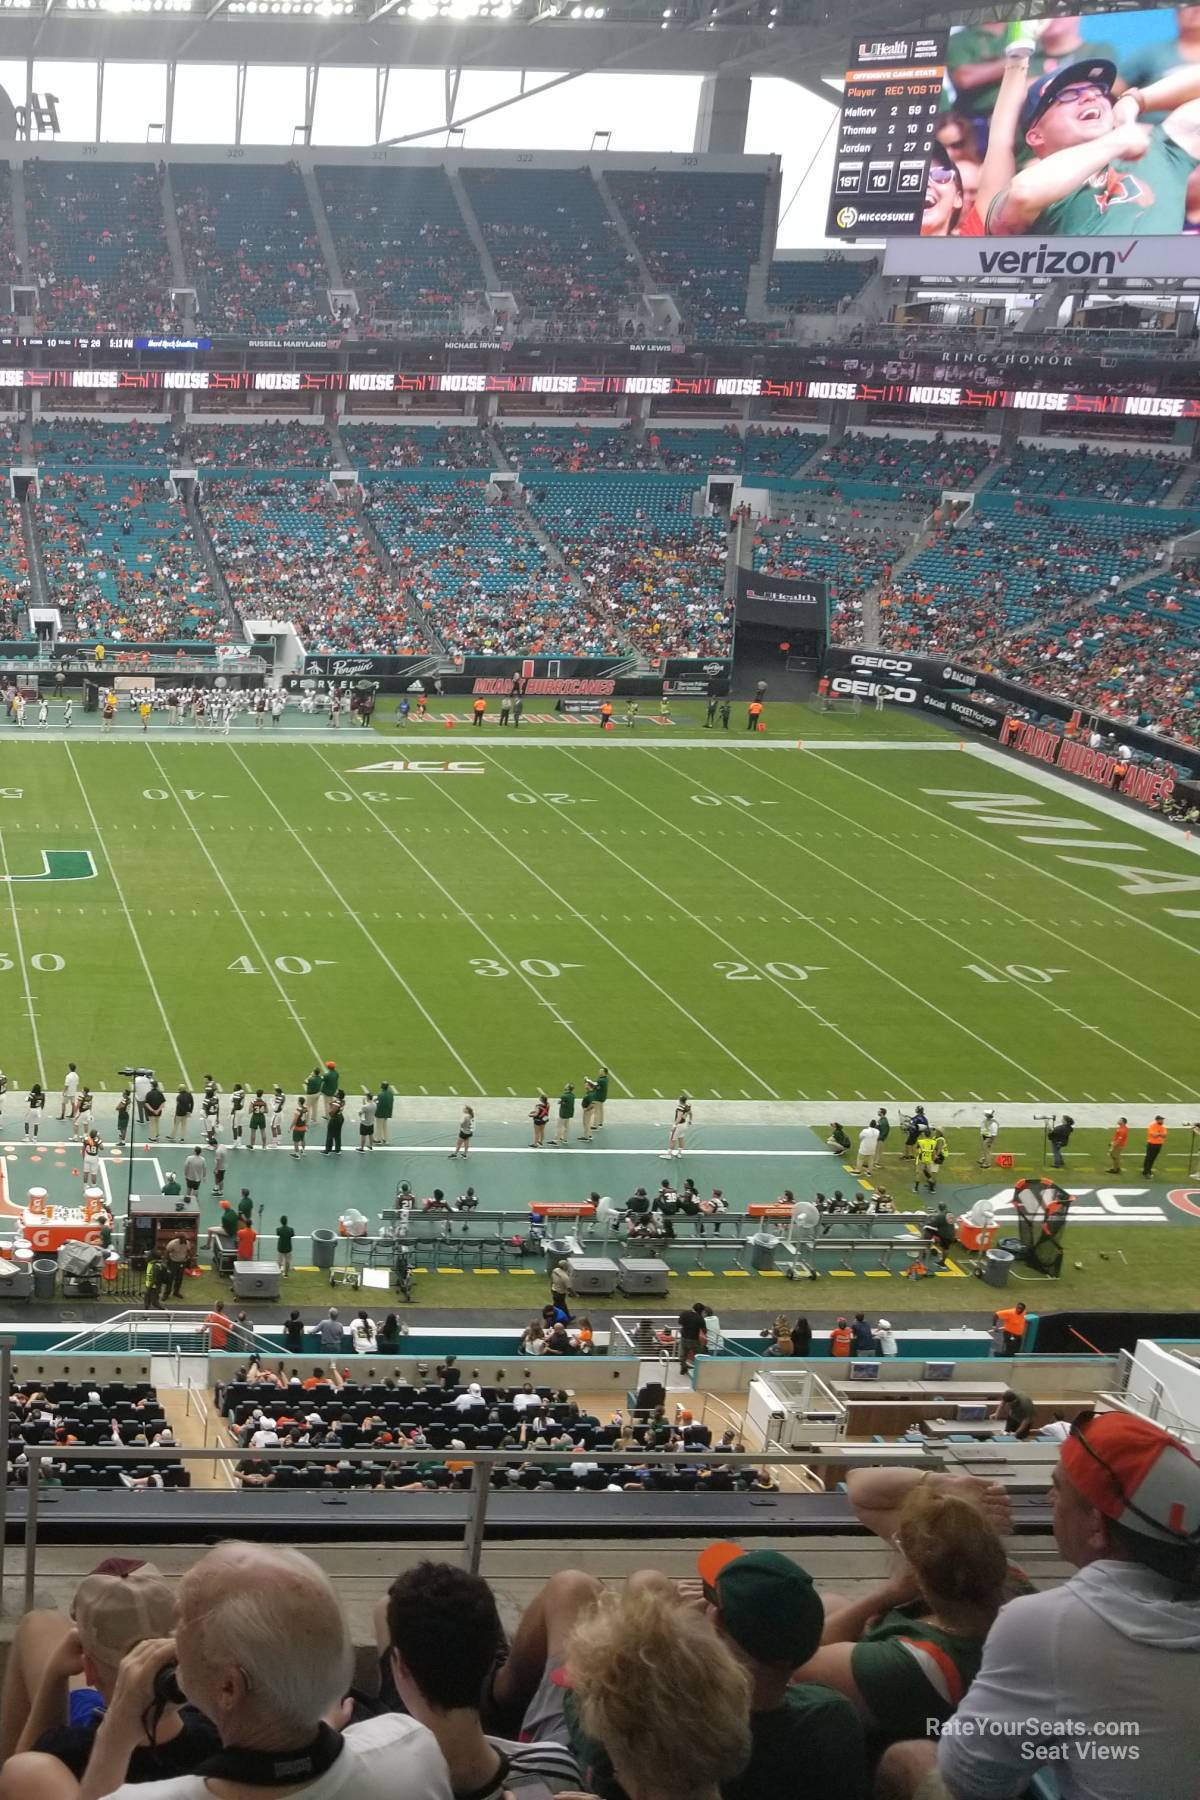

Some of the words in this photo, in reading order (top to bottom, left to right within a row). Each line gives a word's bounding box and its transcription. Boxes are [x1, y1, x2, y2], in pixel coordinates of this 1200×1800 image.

[848, 88, 876, 98] Player
[885, 86, 904, 95] REC
[907, 85, 927, 95] YDS
[929, 84, 941, 93] TD
[845, 107, 877, 117] Mallory
[891, 106, 898, 116] 2
[929, 105, 936, 114] 0
[842, 126, 877, 135] Thomas
[888, 125, 895, 134] 2
[907, 124, 917, 134] 10
[926, 123, 934, 133] 0
[840, 144, 871, 153] Jordan
[904, 143, 916, 152] 27
[924, 142, 931, 151] 0
[840, 177, 859, 187] 1ST
[873, 175, 886, 187] 10
[979, 244, 1116, 275] verizon
[47, 339, 56, 347] 10
[248, 340, 282, 348] RUSSELL
[444, 342, 478, 350] MICHAEL
[479, 342, 500, 350] IRVIN
[942, 353, 987, 362] RING
[1005, 355, 1074, 366] HONOR
[73, 371, 117, 388] NOISE
[164, 372, 209, 389] NOISE
[255, 373, 300, 391] NOISE
[349, 373, 394, 391] NOISE
[440, 375, 486, 392] NOISE
[532, 376, 577, 393] NOISE
[625, 377, 671, 394] NOISE
[716, 378, 762, 396] NOISE
[808, 382, 856, 399] NOISE
[909, 387, 961, 405] NOISE
[1014, 391, 1068, 411] NOISE
[1125, 397, 1185, 417] NOISE
[851, 655, 913, 672] GEICO
[525, 679, 616, 696] HURRICANES
[831, 677, 917, 703] GEICO
[226, 954, 313, 976] 40
[469, 957, 563, 979] 30
[712, 959, 811, 981] 20
[961, 962, 1054, 985] 10
[31, 1230, 49, 1247] G
